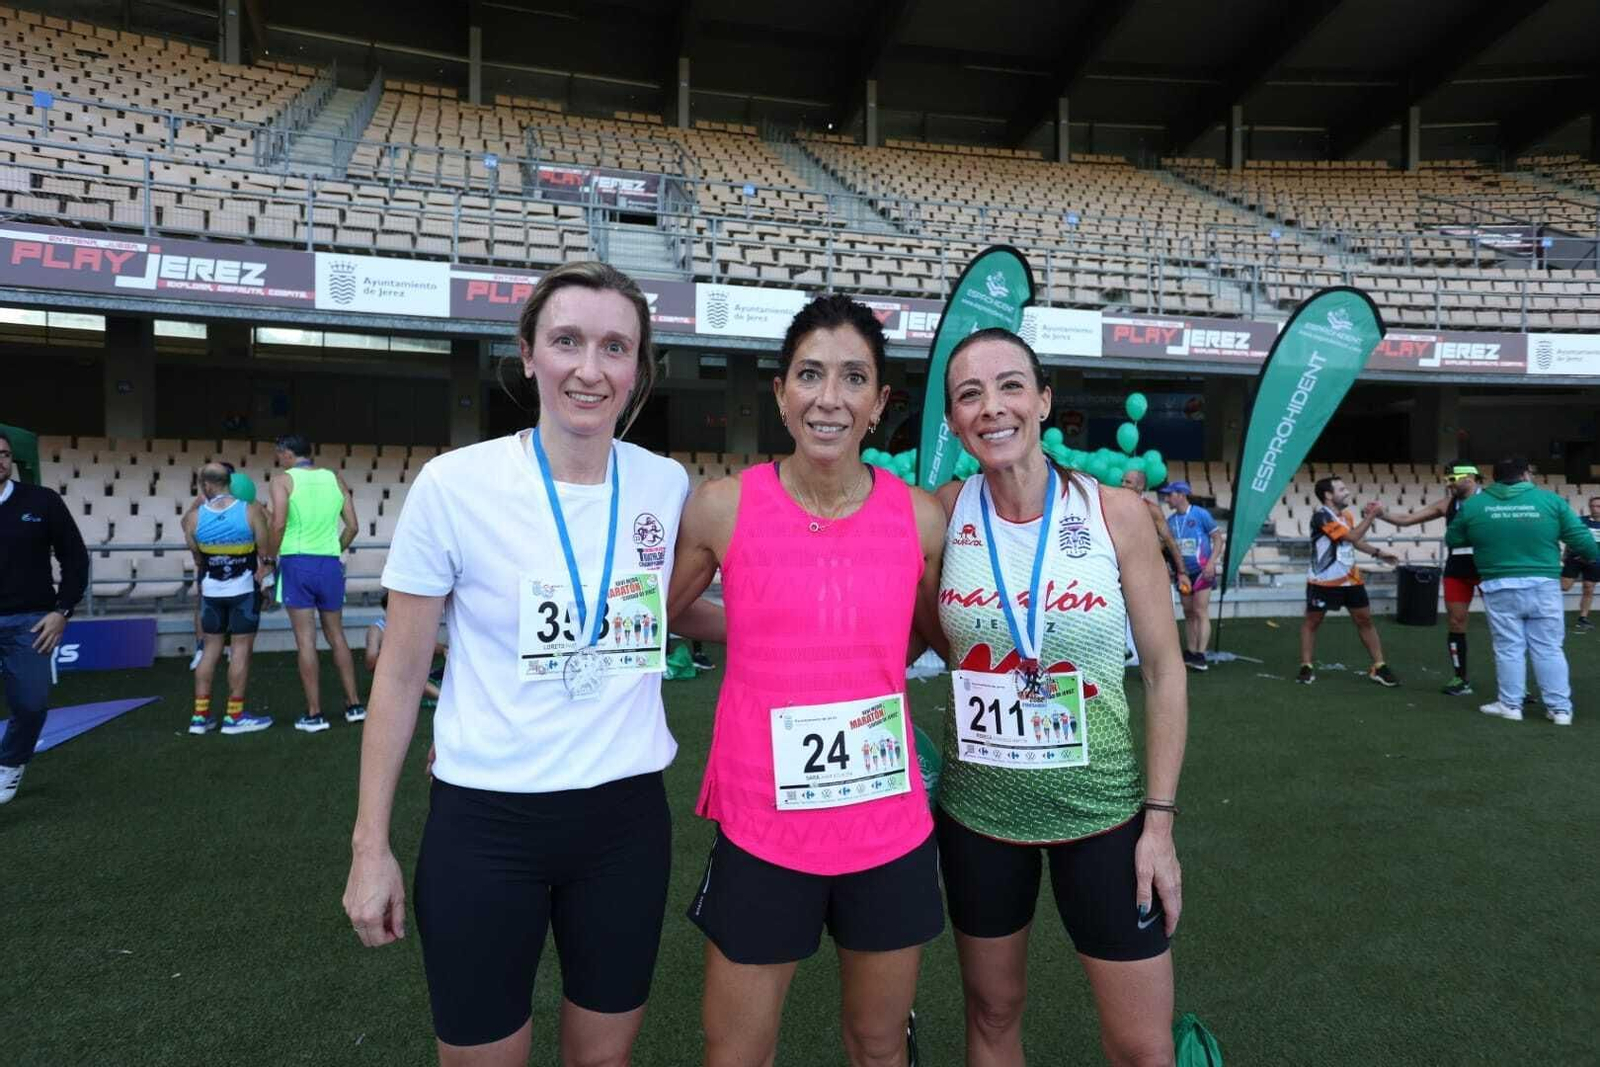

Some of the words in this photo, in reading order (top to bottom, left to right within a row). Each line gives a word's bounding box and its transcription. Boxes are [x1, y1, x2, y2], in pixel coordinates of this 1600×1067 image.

[10, 241, 136, 274] PLAY
[114, 245, 268, 290] JEREZ
[363, 276, 438, 291] Ayuntamiento
[363, 286, 375, 296] de
[378, 288, 405, 298] Jerez
[466, 280, 534, 304] PLA
[1113, 325, 1178, 345] PLAY
[1166, 322, 1251, 356] JEREZ
[1418, 335, 1501, 367] JEREZ
[1251, 350, 1327, 493] ESPROHIDENT
[607, 581, 642, 599] ARATÓN
[974, 617, 1056, 634] JEZ
[968, 695, 1025, 737] 211
[802, 730, 850, 774] 24
